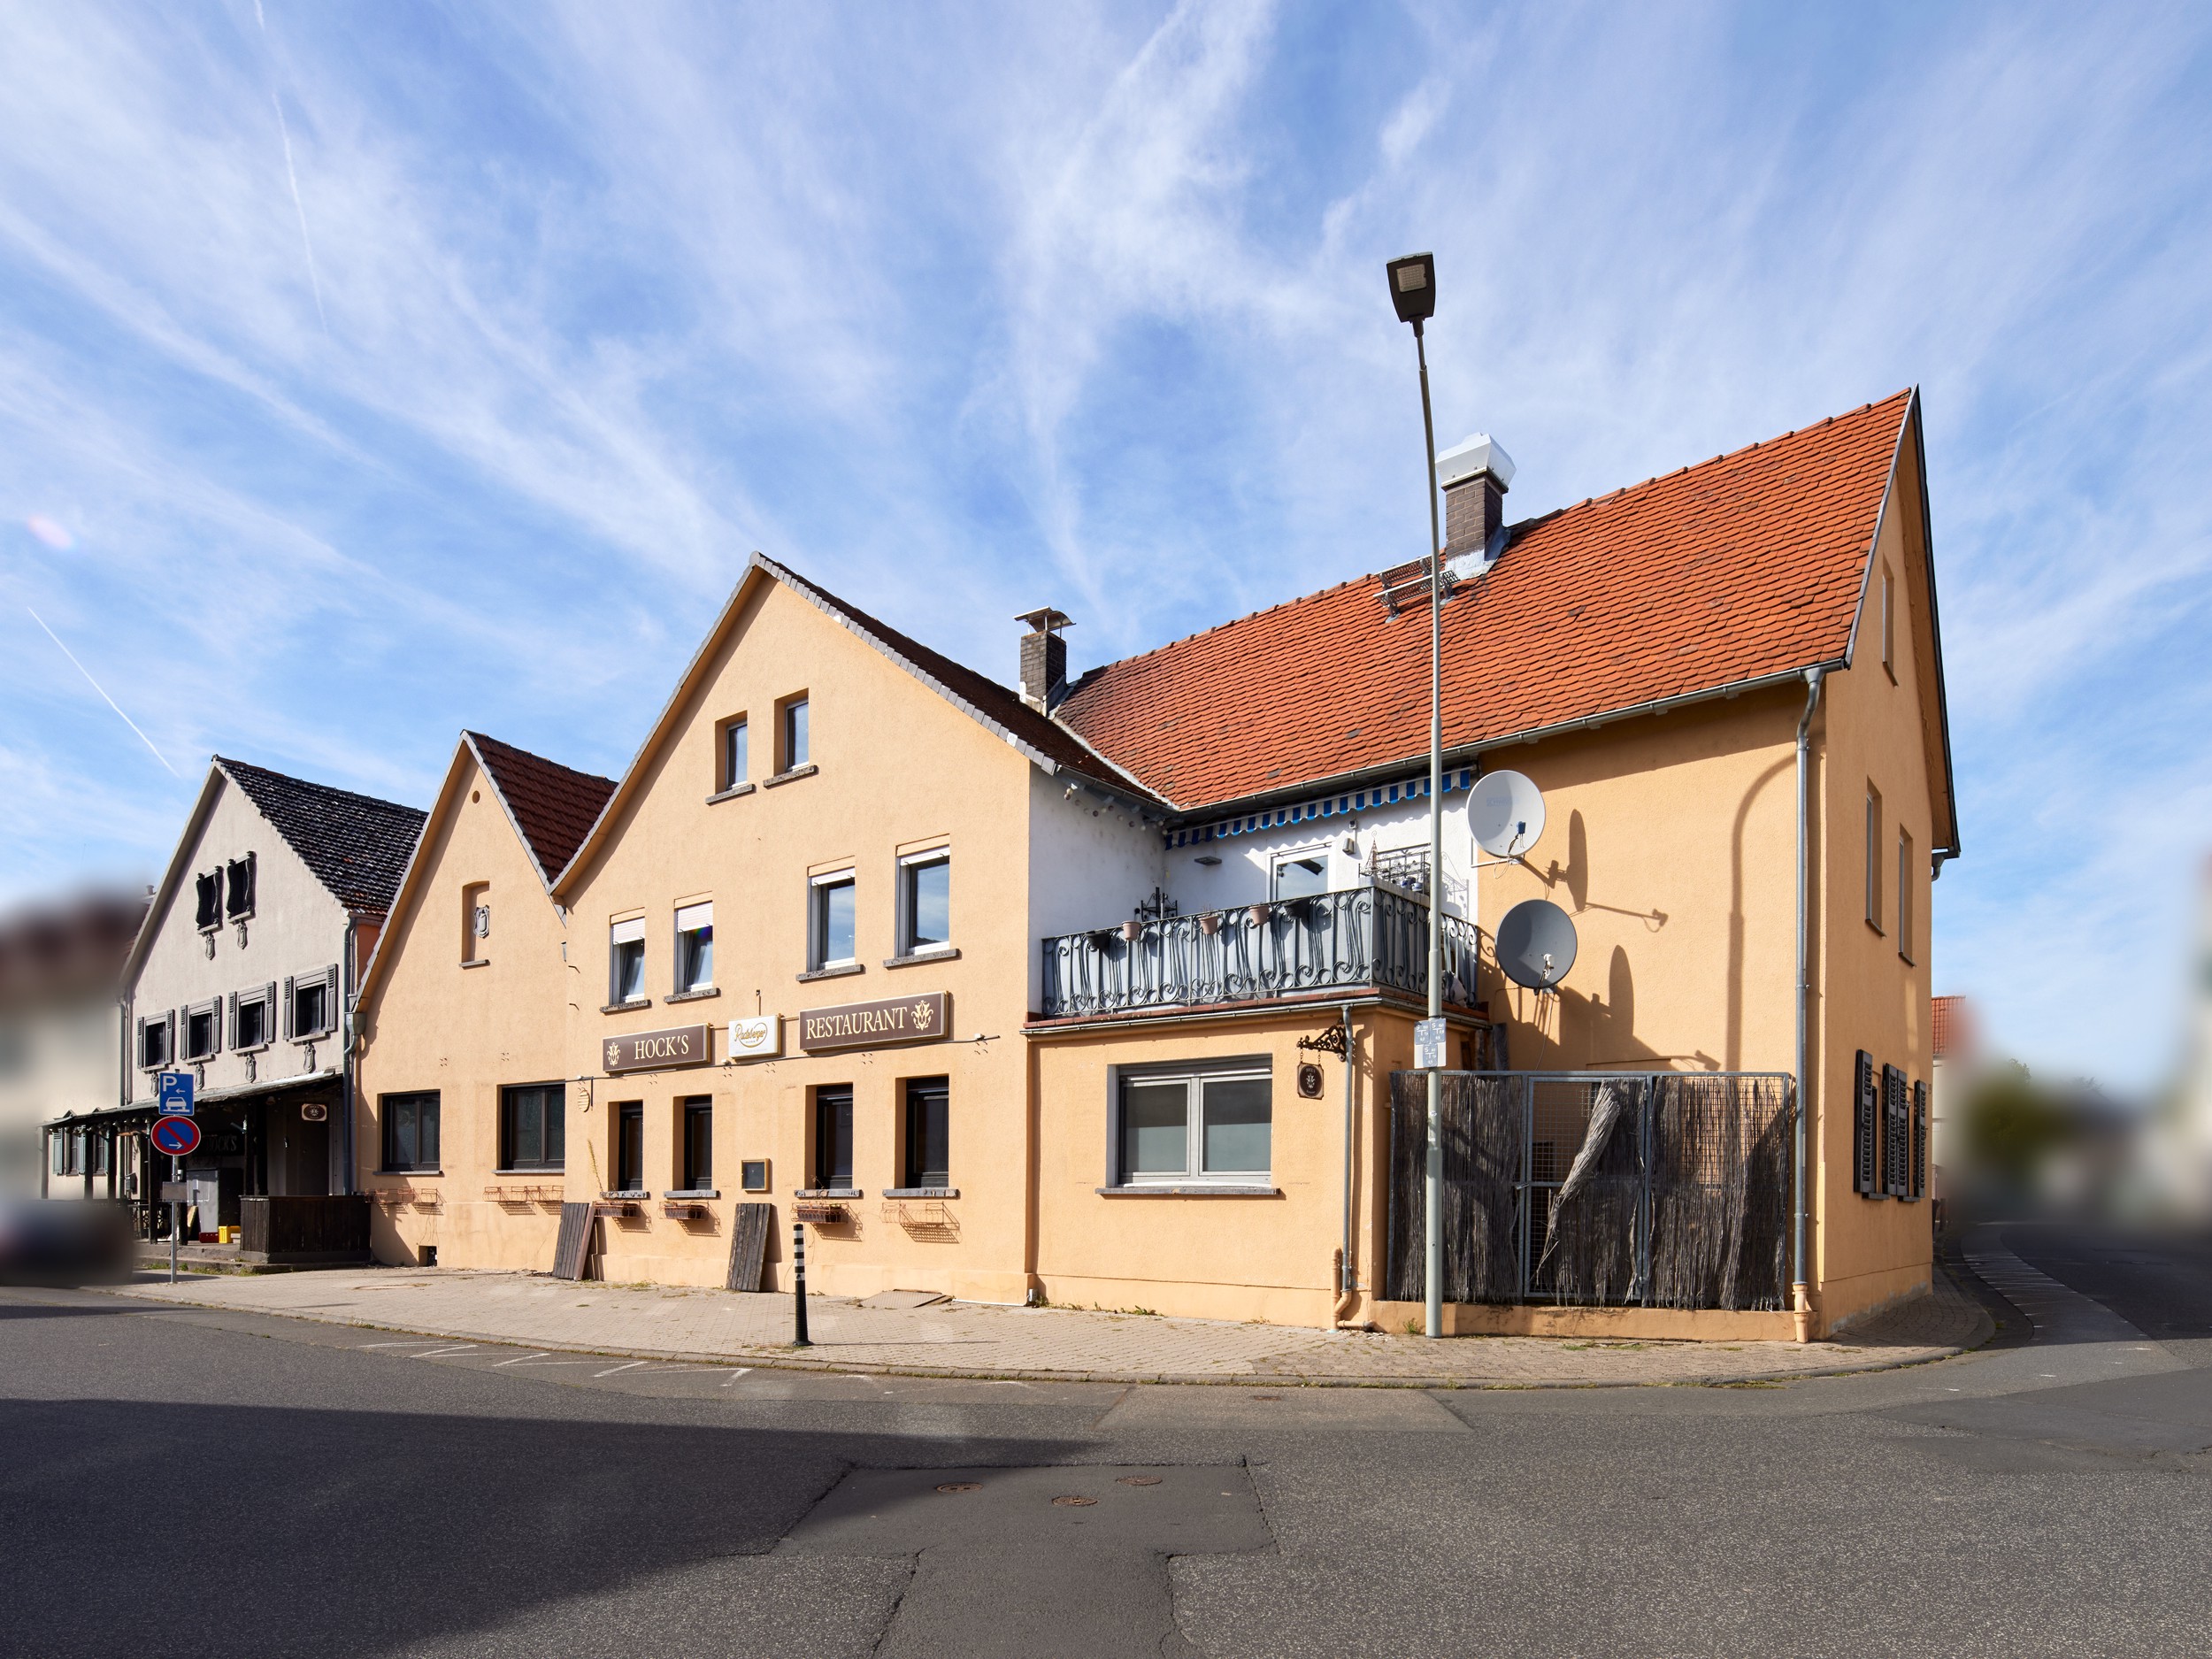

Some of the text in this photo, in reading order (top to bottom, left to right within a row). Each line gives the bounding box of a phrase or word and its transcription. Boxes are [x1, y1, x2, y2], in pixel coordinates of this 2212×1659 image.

[806, 1007, 907, 1040] RESTAURANT
[634, 1034, 689, 1060] HOCK'S
[163, 1075, 178, 1092] P
